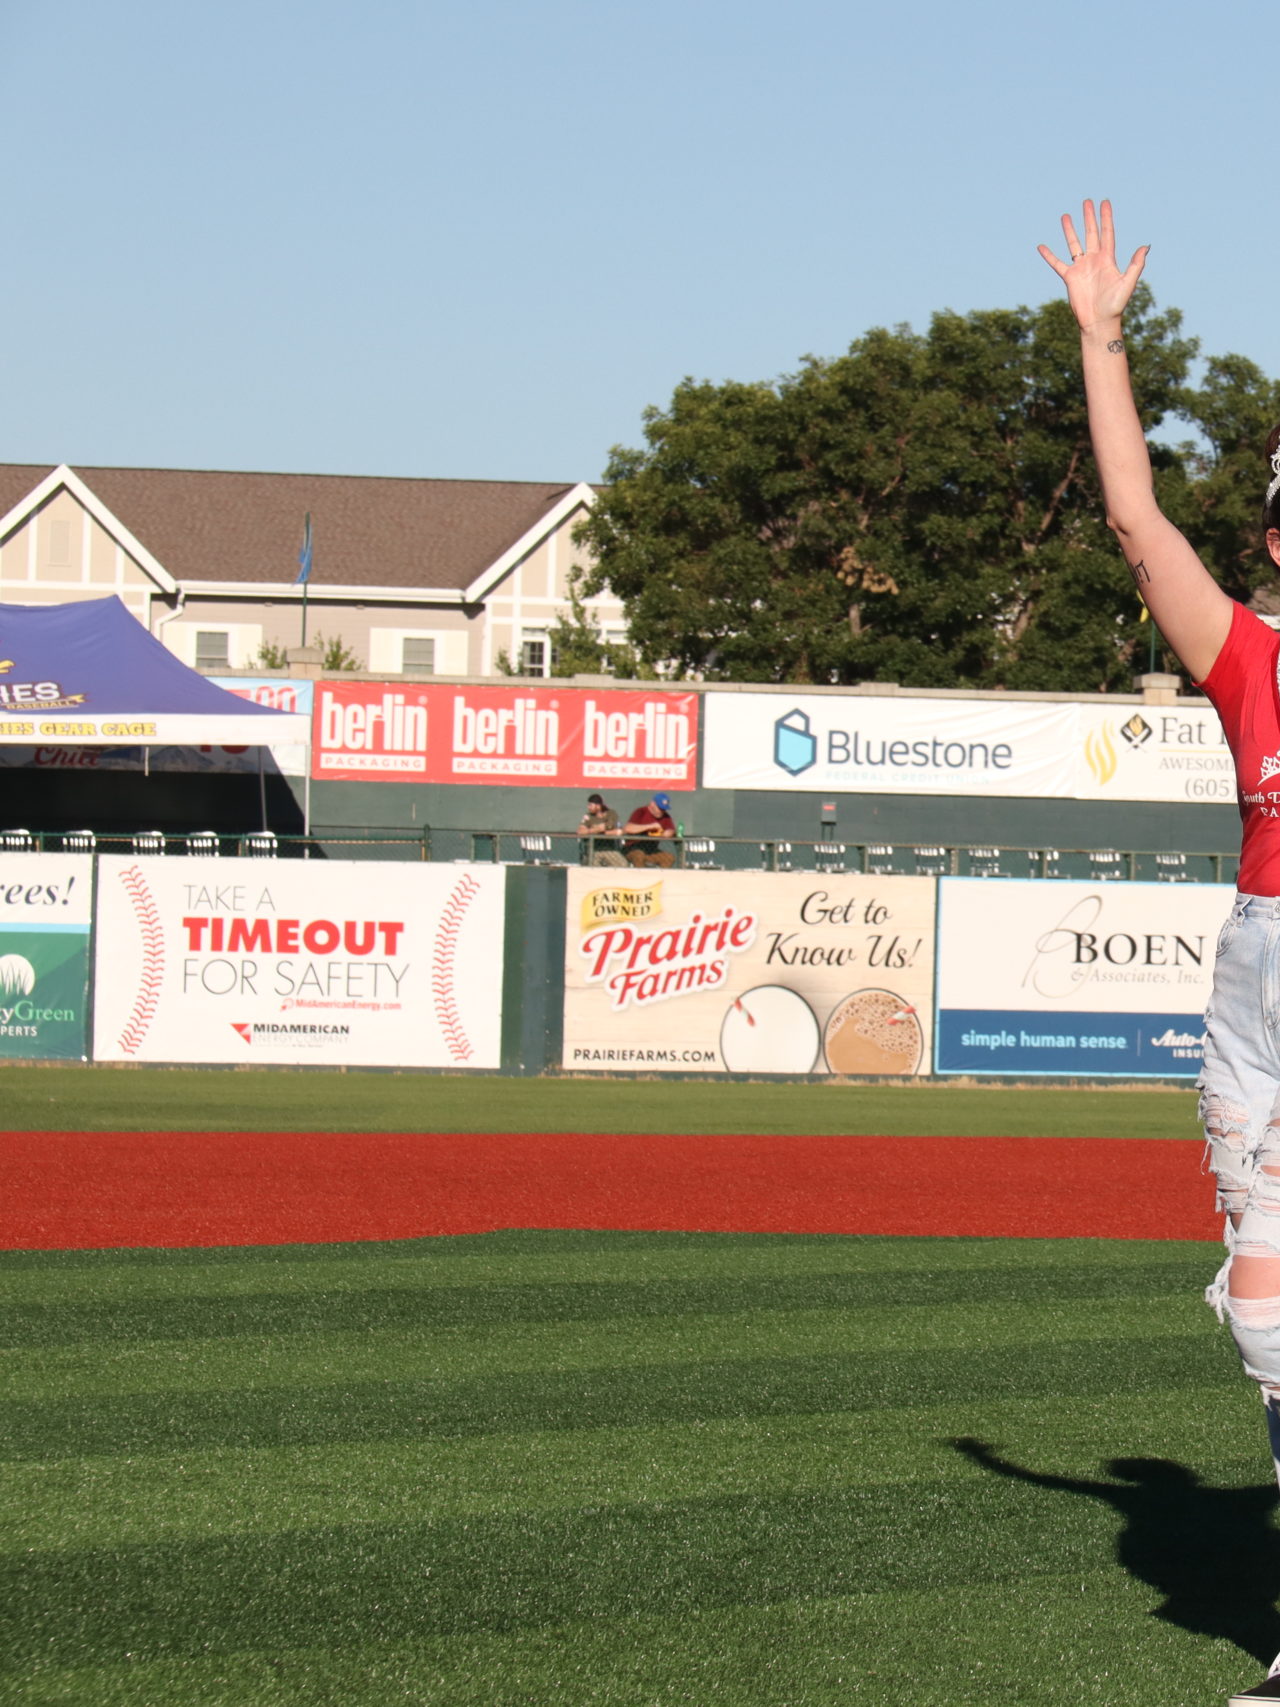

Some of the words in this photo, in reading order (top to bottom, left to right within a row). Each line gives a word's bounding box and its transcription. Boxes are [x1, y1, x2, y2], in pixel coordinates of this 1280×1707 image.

[40, 722, 97, 736] GEAR
[101, 722, 157, 736] CAGE
[321, 692, 427, 752] berlin
[454, 696, 558, 756] berlin
[584, 700, 689, 760] berlin
[1159, 717, 1208, 746] Fat
[324, 757, 423, 769] PACKAGING
[828, 730, 1012, 769] Bluestone
[457, 761, 554, 774] PACKAGING
[587, 764, 684, 778] PACKAGING
[0, 876, 75, 905] ees!
[183, 884, 246, 911] TAKE
[256, 887, 276, 912] A
[592, 890, 653, 905] FARMER
[594, 904, 651, 918] OWNED
[800, 890, 854, 925] Get
[864, 897, 892, 926] to
[183, 917, 404, 956] TIMEOUT
[582, 908, 754, 977] Prairie
[765, 932, 855, 967] Know
[867, 935, 922, 969] Us!
[1072, 932, 1207, 966] BOEN
[183, 958, 258, 995] FOR
[275, 961, 409, 998] SAFETY
[610, 959, 725, 1006] Farms
[1071, 969, 1085, 983] &
[1090, 969, 1171, 985] Associates,
[1177, 970, 1205, 985] Inc.
[0, 1000, 75, 1024] yGreen
[295, 999, 402, 1011] MidAmericanEnergy.com
[253, 1023, 350, 1036] MIDAMERICAN
[961, 1030, 1016, 1051] simple
[1020, 1031, 1076, 1049] human
[1080, 1035, 1128, 1049] sense
[573, 1049, 715, 1063] PRAIRIEFARMS.COM
[1171, 1048, 1204, 1059] INSU
